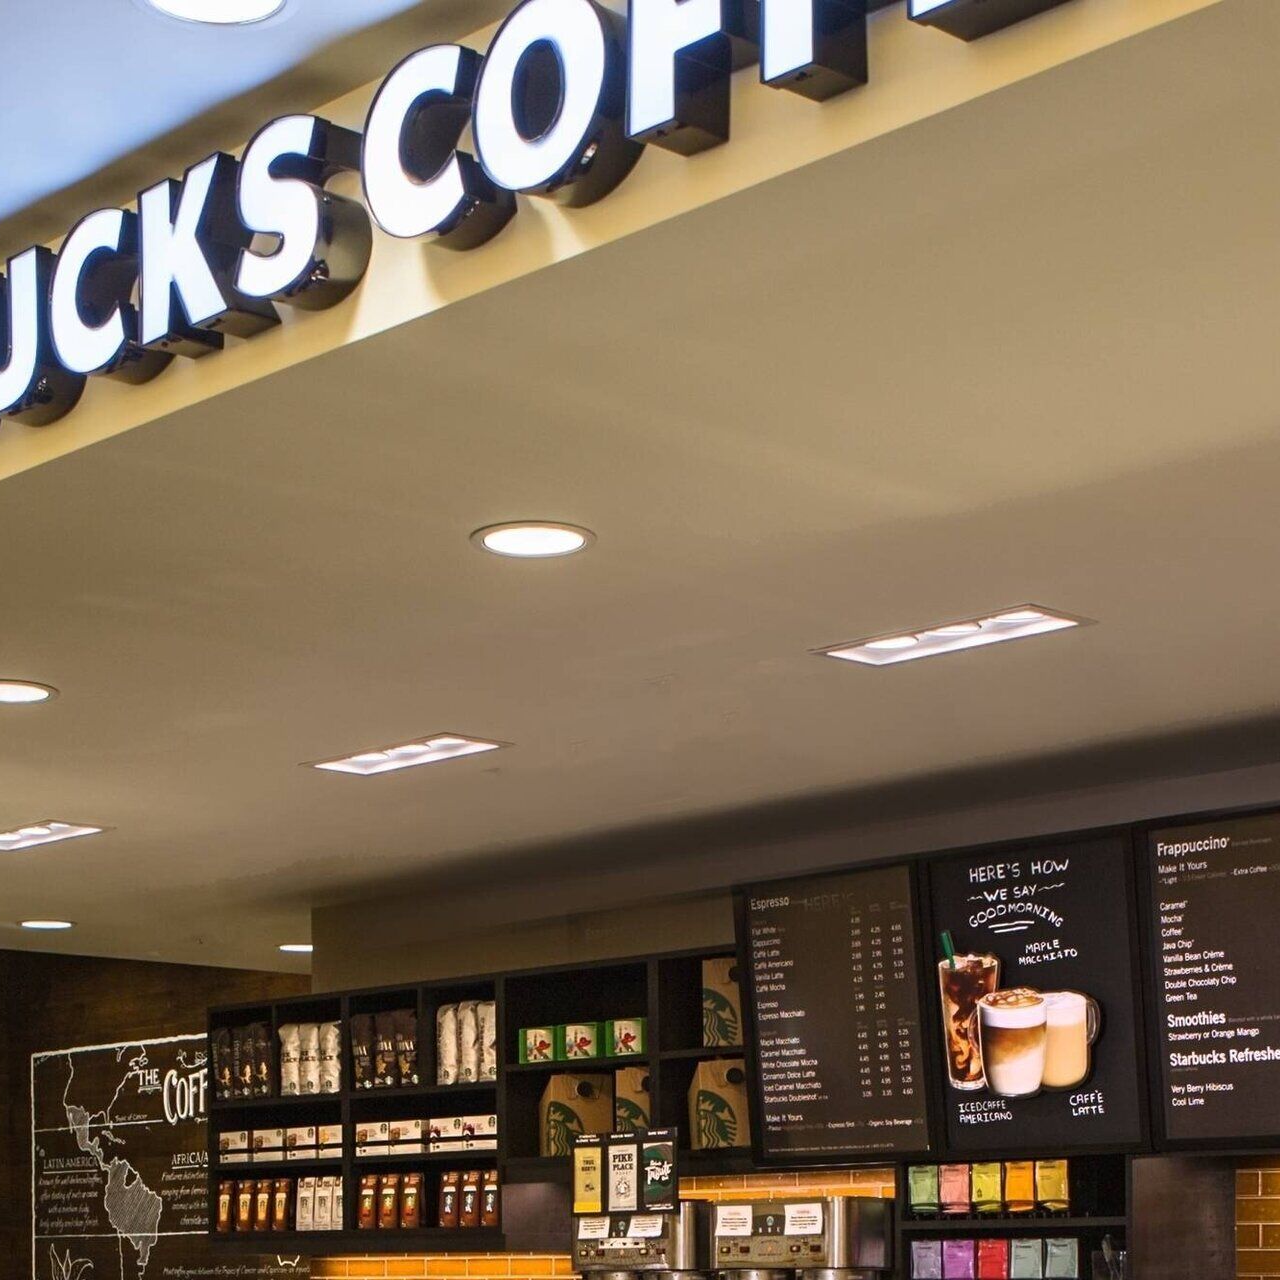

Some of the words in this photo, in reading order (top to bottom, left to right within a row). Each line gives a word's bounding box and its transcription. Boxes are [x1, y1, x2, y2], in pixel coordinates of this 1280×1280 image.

[360, 0, 1000, 239] COF
[970, 863, 1020, 883] HERE'S
[1031, 859, 1068, 875] HOW
[1158, 864, 1176, 874] Make
[1179, 863, 1184, 871] It
[1187, 861, 1207, 871] Yours
[983, 889, 1007, 902] WE
[1014, 885, 1037, 898] SAY
[751, 896, 790, 912] Espresso
[1026, 939, 1060, 954] MAPLE
[1163, 941, 1176, 950] Java
[1019, 949, 1077, 965] MACCHIATO
[1163, 954, 1183, 963] Vanilla
[1185, 952, 1201, 961] Bean
[1204, 964, 1210, 972] &
[1165, 980, 1187, 990] Double
[1221, 976, 1236, 985] Chip
[1165, 994, 1184, 1003] Green
[1186, 992, 1197, 1000] Tea
[1167, 1011, 1226, 1028] Smoothies
[1168, 1031, 1202, 1041] Strawberry
[1212, 1030, 1234, 1039] Orange
[1236, 1028, 1259, 1037] Mango
[1170, 1051, 1226, 1067] Starbucks
[1171, 1084, 1185, 1094] Very
[1187, 1084, 1204, 1093] Berry
[1206, 1082, 1234, 1091] Hibiscus
[139, 1069, 159, 1085] THE
[163, 1068, 207, 1125] COFF
[1172, 1098, 1186, 1106] Cool
[1188, 1097, 1204, 1106] Lime
[1072, 1105, 1104, 1116] LATTE
[959, 1111, 1012, 1124] AMERICANO
[43, 1158, 65, 1169] LATIN
[612, 1154, 632, 1162] PIKE
[613, 1163, 633, 1171] PLACE
